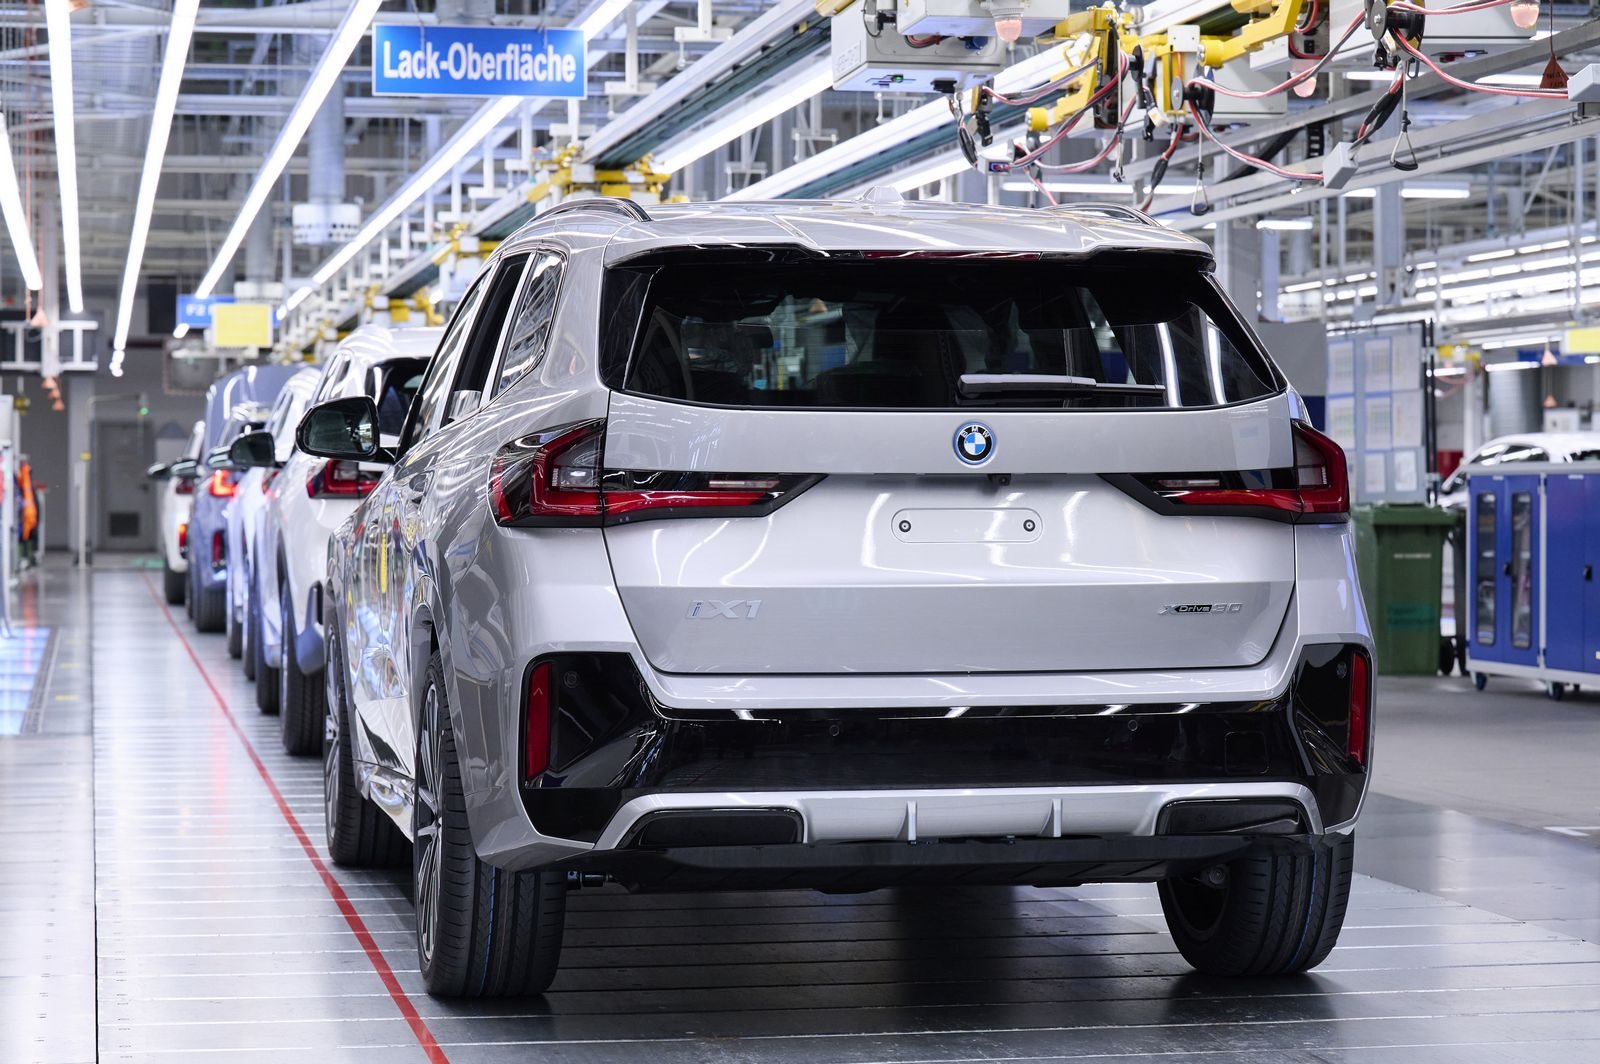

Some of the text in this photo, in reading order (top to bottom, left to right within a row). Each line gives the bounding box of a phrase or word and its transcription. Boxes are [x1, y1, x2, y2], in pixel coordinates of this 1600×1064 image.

[384, 41, 577, 82] Lack-Oberfläche
[960, 425, 990, 438] BMW
[685, 599, 762, 619] iX1
